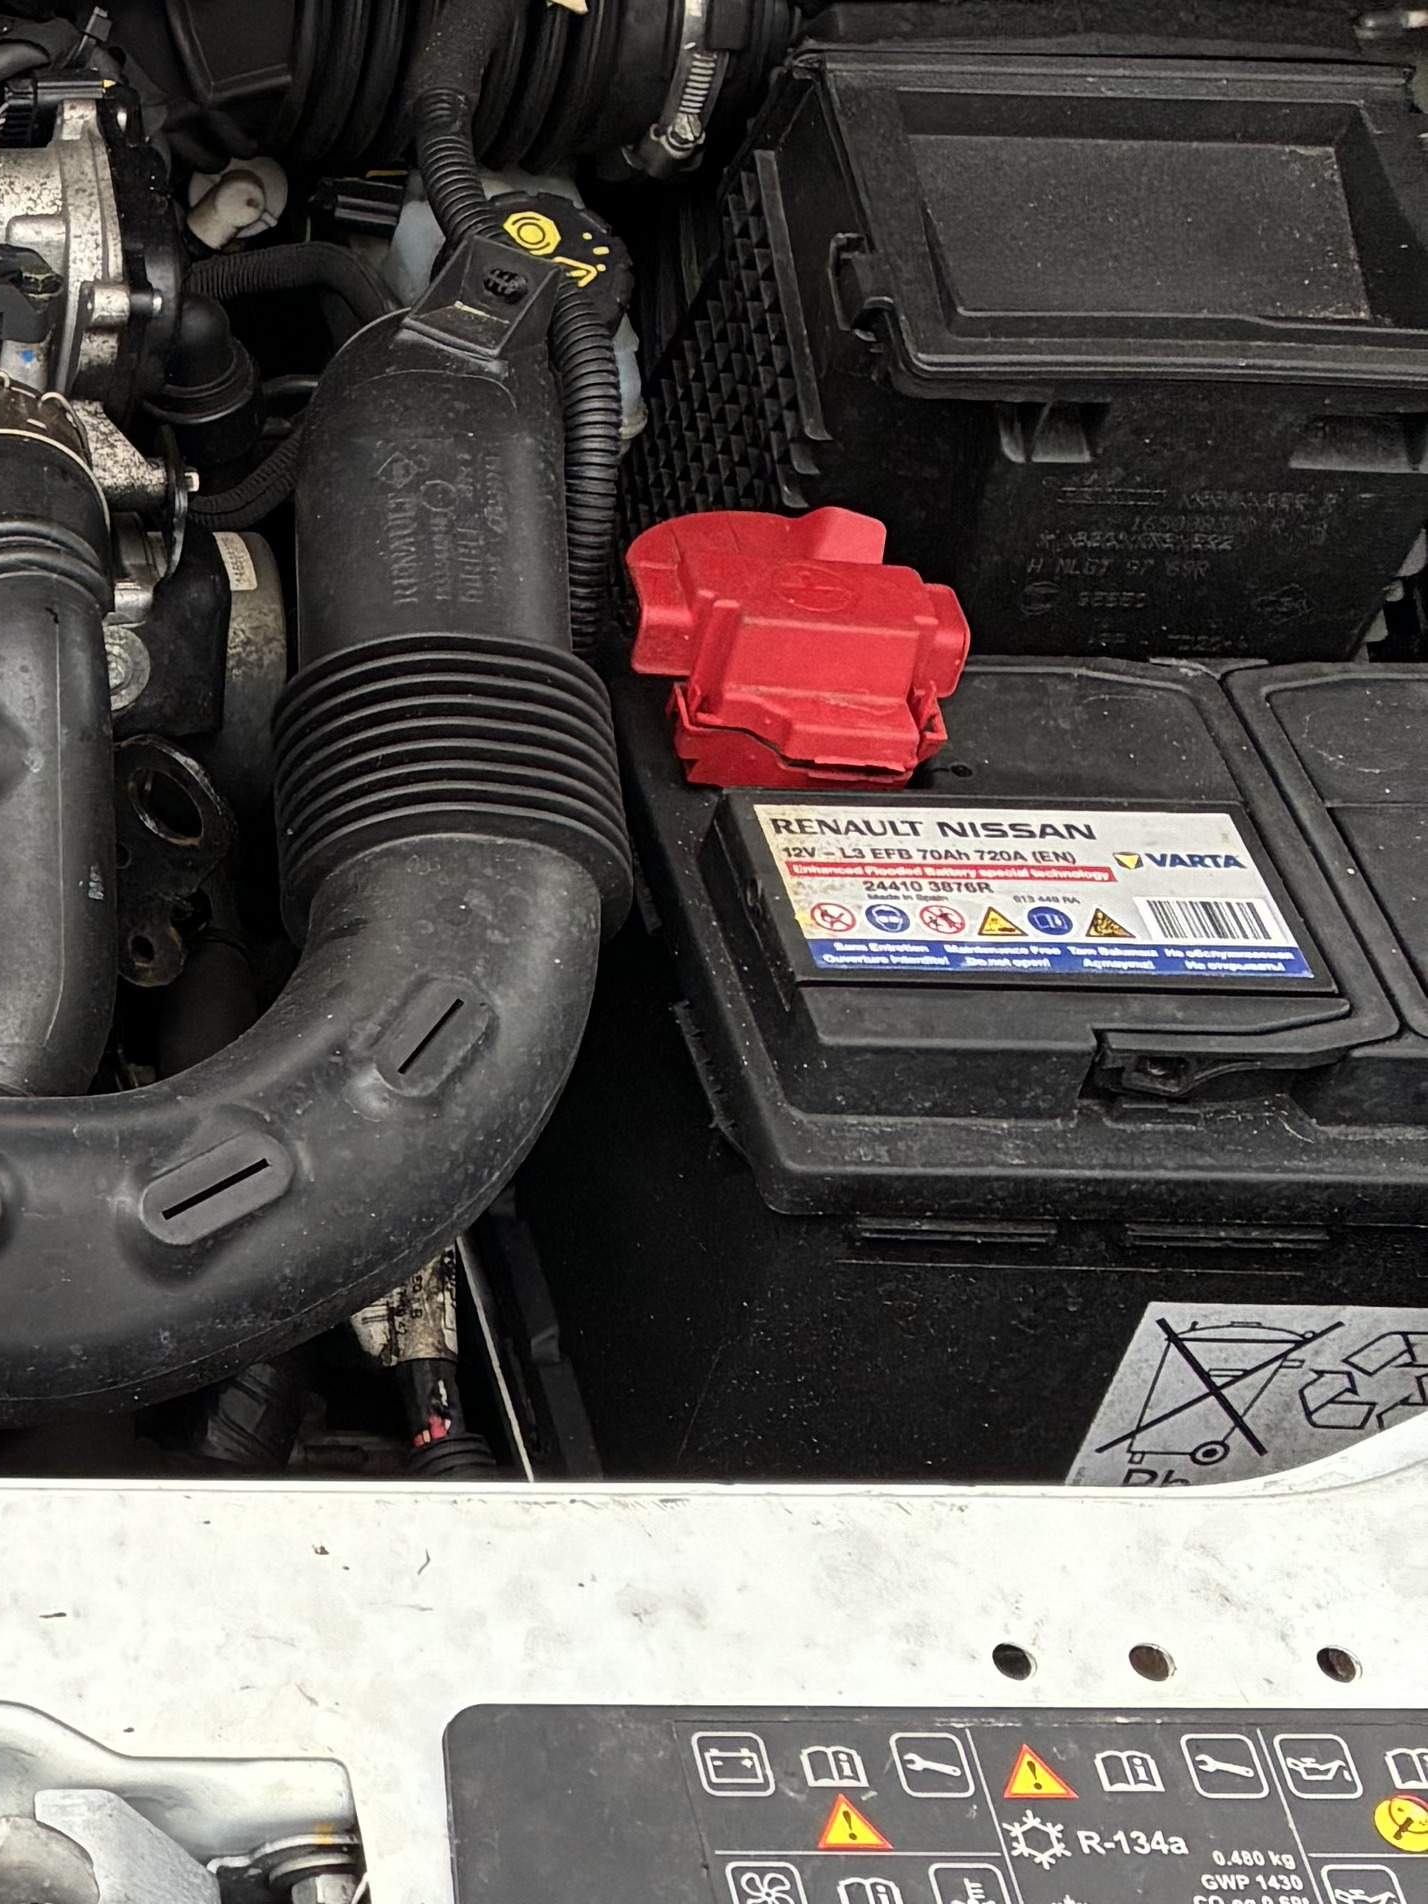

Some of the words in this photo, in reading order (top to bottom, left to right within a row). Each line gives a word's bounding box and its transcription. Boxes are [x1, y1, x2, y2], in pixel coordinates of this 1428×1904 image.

[770, 818, 924, 837] RENAULT
[936, 821, 1096, 840] NISSAN
[785, 847, 817, 859] 12V
[844, 847, 865, 859] L3
[872, 848, 913, 860] EFB
[918, 848, 970, 861] 70Ah
[978, 850, 1027, 862] 720A
[1032, 850, 1076, 864] (EN)
[1145, 852, 1247, 870] VARTA
[1076, 1830, 1191, 1856] R-134a
[1212, 1850, 1265, 1866] 0.480
[1268, 1850, 1296, 1870] kg
[1201, 1874, 1249, 1890] GWP
[1255, 1875, 1303, 1890] 1430
